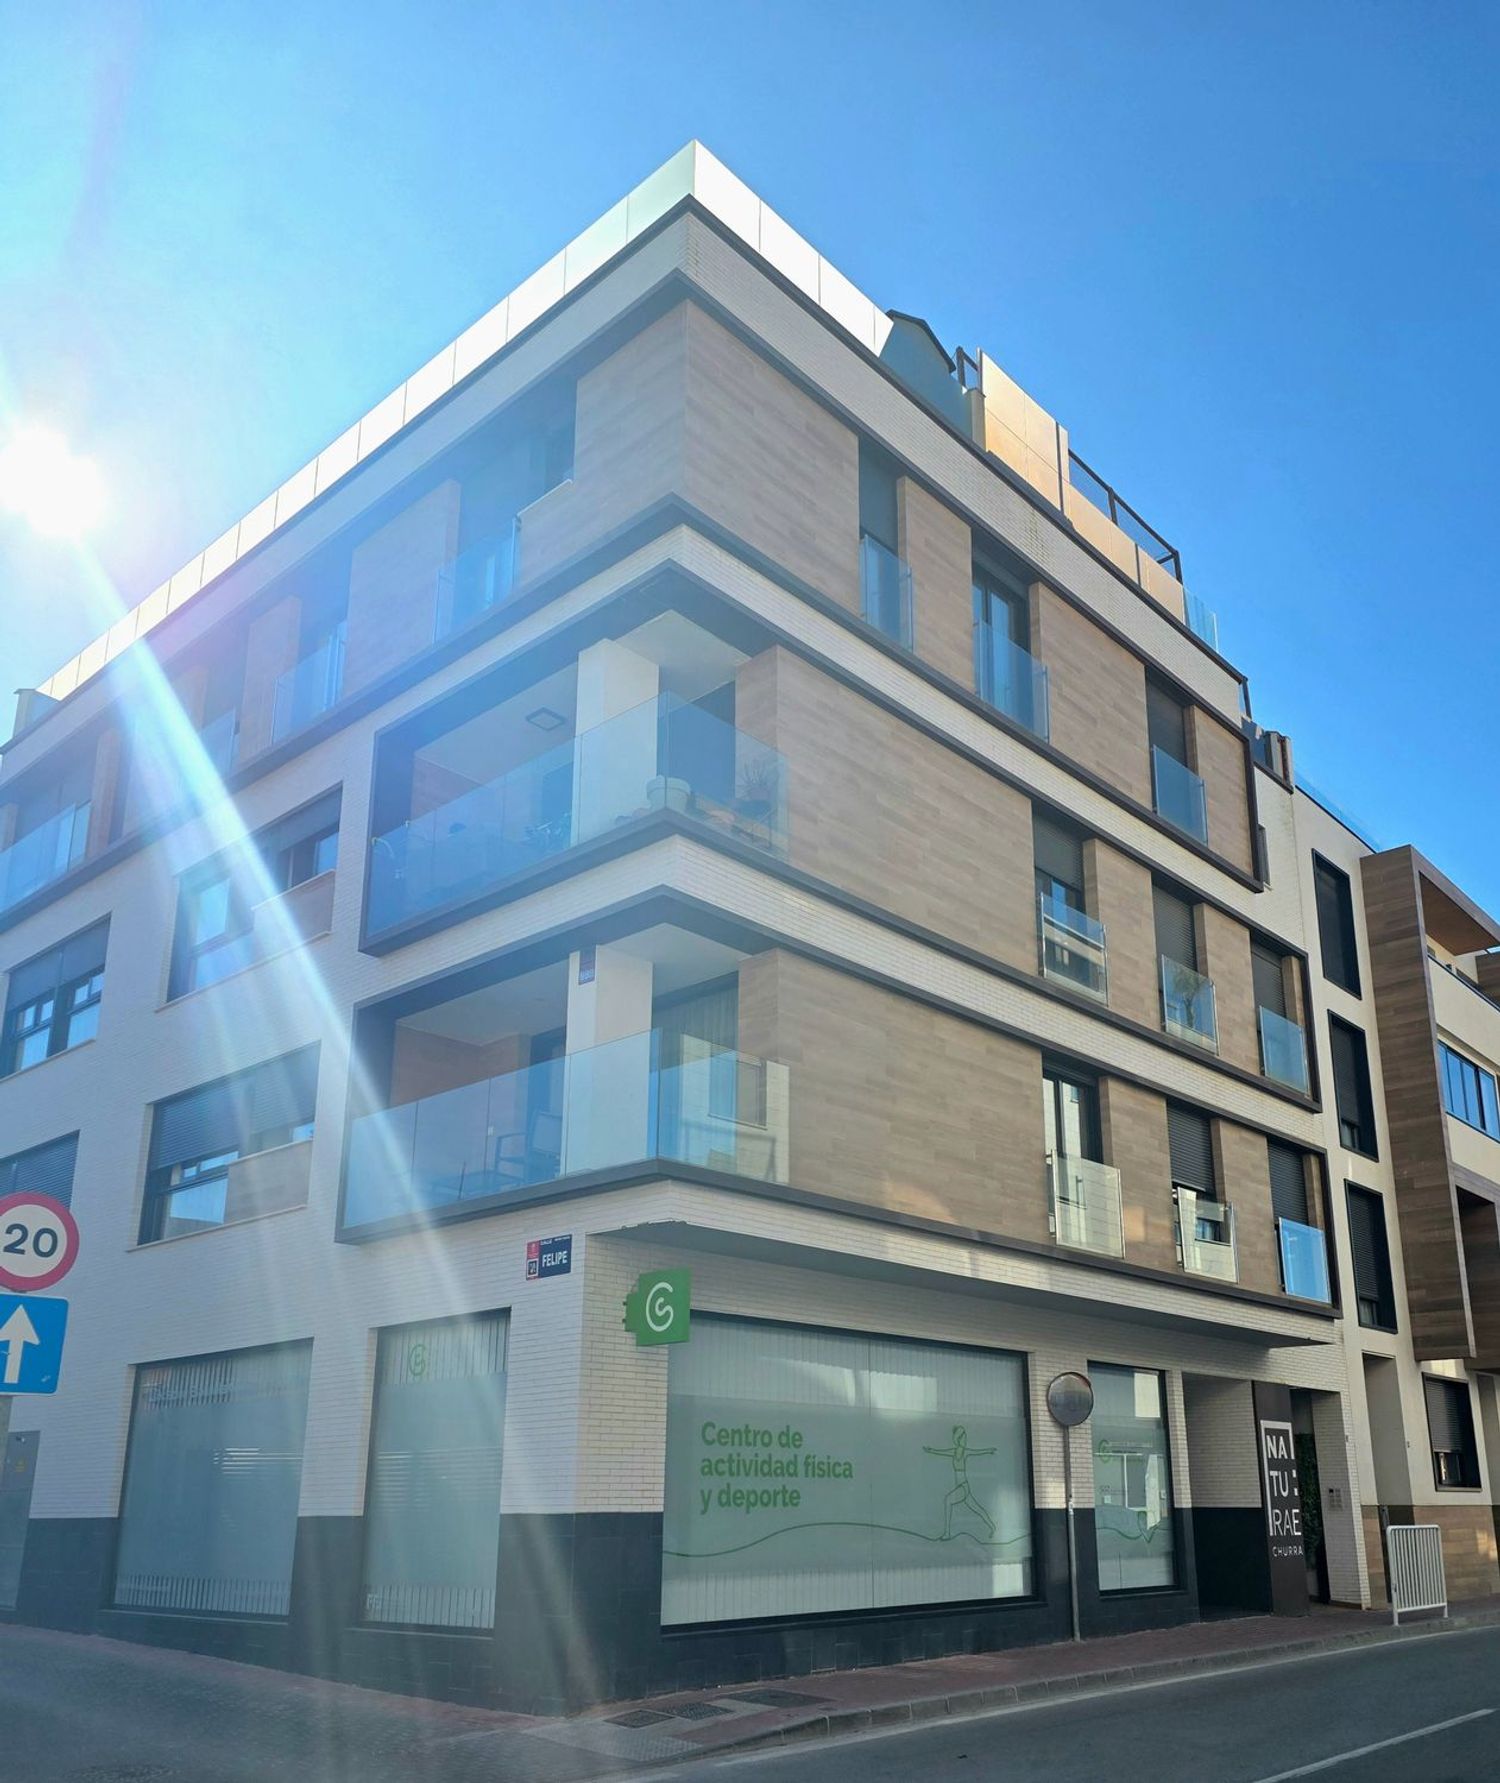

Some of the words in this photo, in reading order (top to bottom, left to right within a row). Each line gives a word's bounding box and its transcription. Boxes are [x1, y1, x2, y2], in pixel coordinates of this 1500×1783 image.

[3, 1223, 58, 1258] 20
[542, 1250, 568, 1267] FELIPE
[701, 1421, 773, 1448] Centro
[777, 1425, 803, 1449] de
[700, 1453, 799, 1477] actividad
[700, 1489, 713, 1515] y
[717, 1482, 801, 1514] deporte
[1272, 1508, 1302, 1536] RAE
[1271, 1545, 1304, 1557] CHURRA
